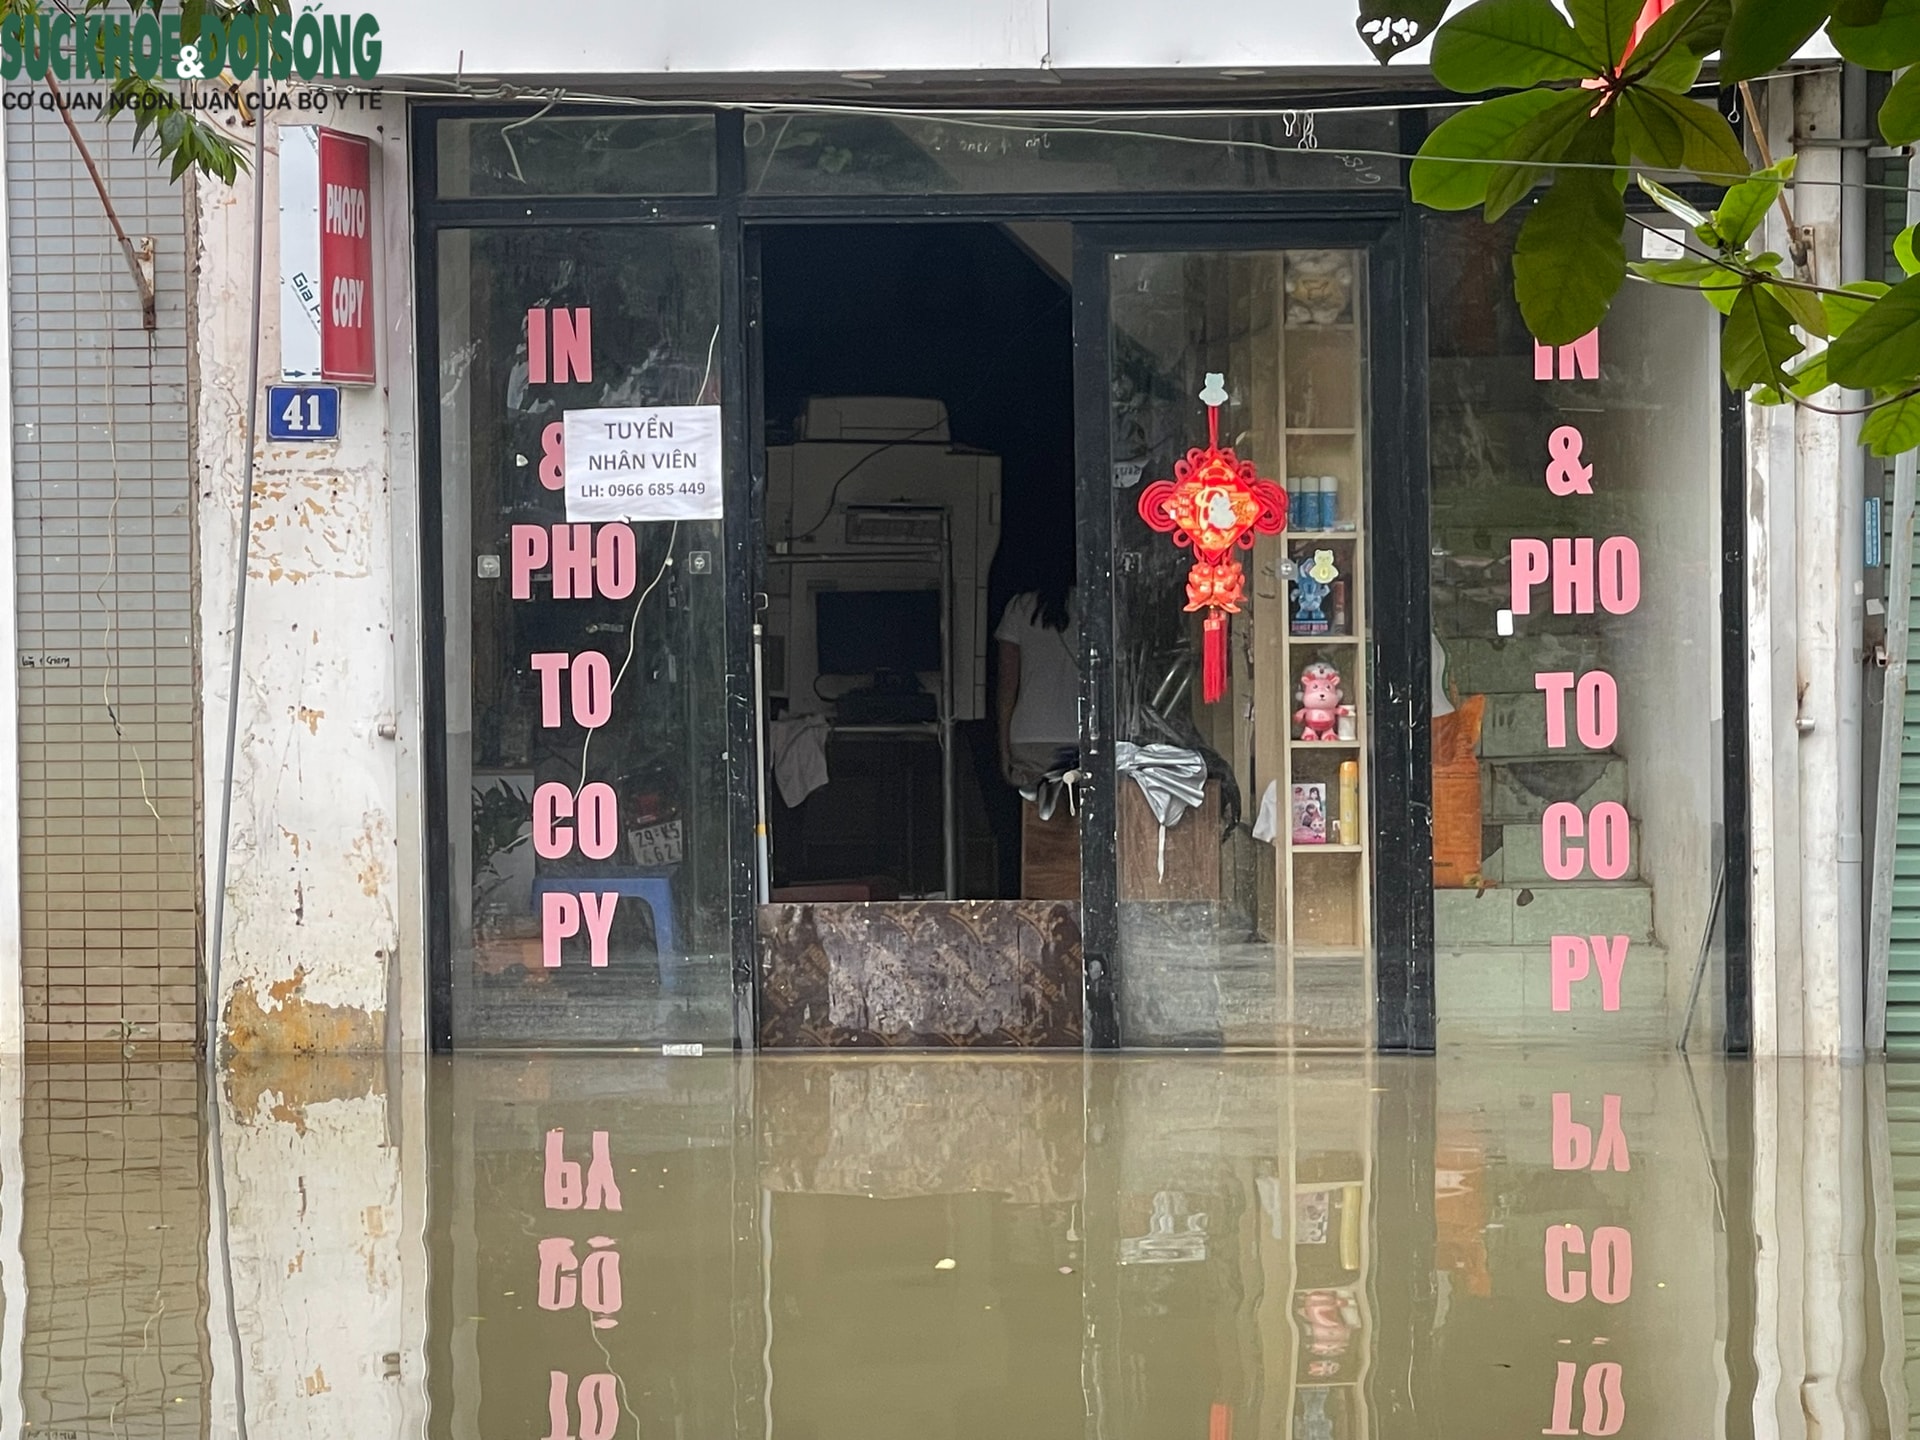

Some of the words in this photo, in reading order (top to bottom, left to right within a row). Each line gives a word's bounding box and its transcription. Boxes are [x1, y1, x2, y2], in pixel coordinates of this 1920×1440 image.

[326, 183, 366, 239] PHOTO
[332, 275, 364, 329] COPY
[528, 308, 593, 383] IN
[282, 394, 322, 431] 41
[604, 413, 674, 440] TUYỂN
[581, 485, 604, 498] LH:
[608, 484, 644, 497] 0966
[648, 483, 674, 496] 685
[678, 482, 706, 495] 449
[589, 450, 646, 471] NHÂN
[652, 449, 697, 469] VIÊN
[1546, 426, 1594, 495] &
[511, 523, 636, 599] PHO
[1510, 536, 1640, 615] PHO
[531, 650, 612, 728] TO
[1535, 671, 1618, 748] TO
[532, 782, 618, 859] CO
[1541, 801, 1629, 880] CO
[541, 892, 619, 967] PY
[1551, 935, 1630, 1011] PY
